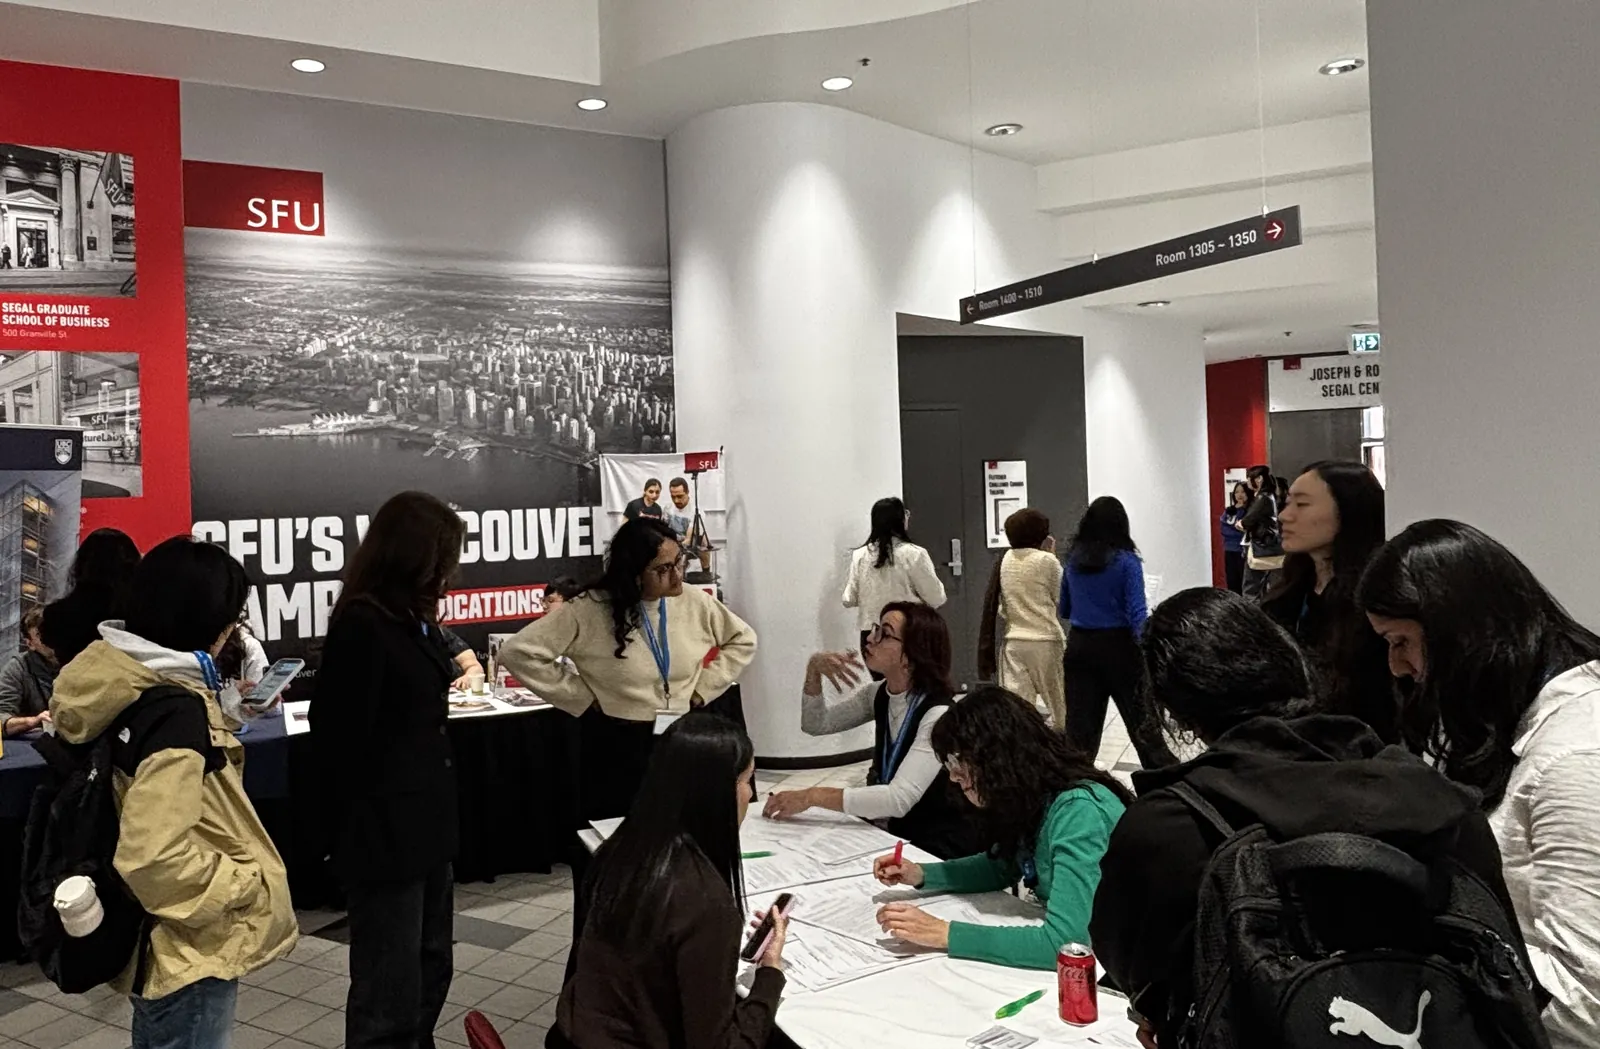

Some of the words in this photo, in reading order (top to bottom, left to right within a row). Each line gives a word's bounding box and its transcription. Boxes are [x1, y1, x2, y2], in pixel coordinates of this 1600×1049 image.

[247, 197, 320, 231] SFU
[1155, 253, 1187, 266] Room
[1188, 240, 1215, 258] 1305
[1228, 229, 1257, 248] 1350
[979, 300, 999, 311] Room
[1025, 285, 1043, 299] 1510
[2, 302, 35, 314] SEGAL
[36, 304, 91, 316] GRADUATE
[2, 314, 43, 326] SCHOOL
[44, 316, 58, 326] OF
[60, 317, 110, 328] BUSINESS
[2, 329, 18, 337] 500
[19, 330, 57, 338] Granville
[1310, 366, 1351, 381] JOSEPH
[1354, 365, 1362, 378] &
[1365, 364, 1380, 377] RO
[1321, 383, 1355, 397] SEGAL
[1358, 382, 1380, 395] CEN
[91, 414, 109, 425] SFU
[84, 432, 124, 442] tureLabs
[699, 460, 718, 469] SFU
[437, 588, 545, 621] OCATIONS
